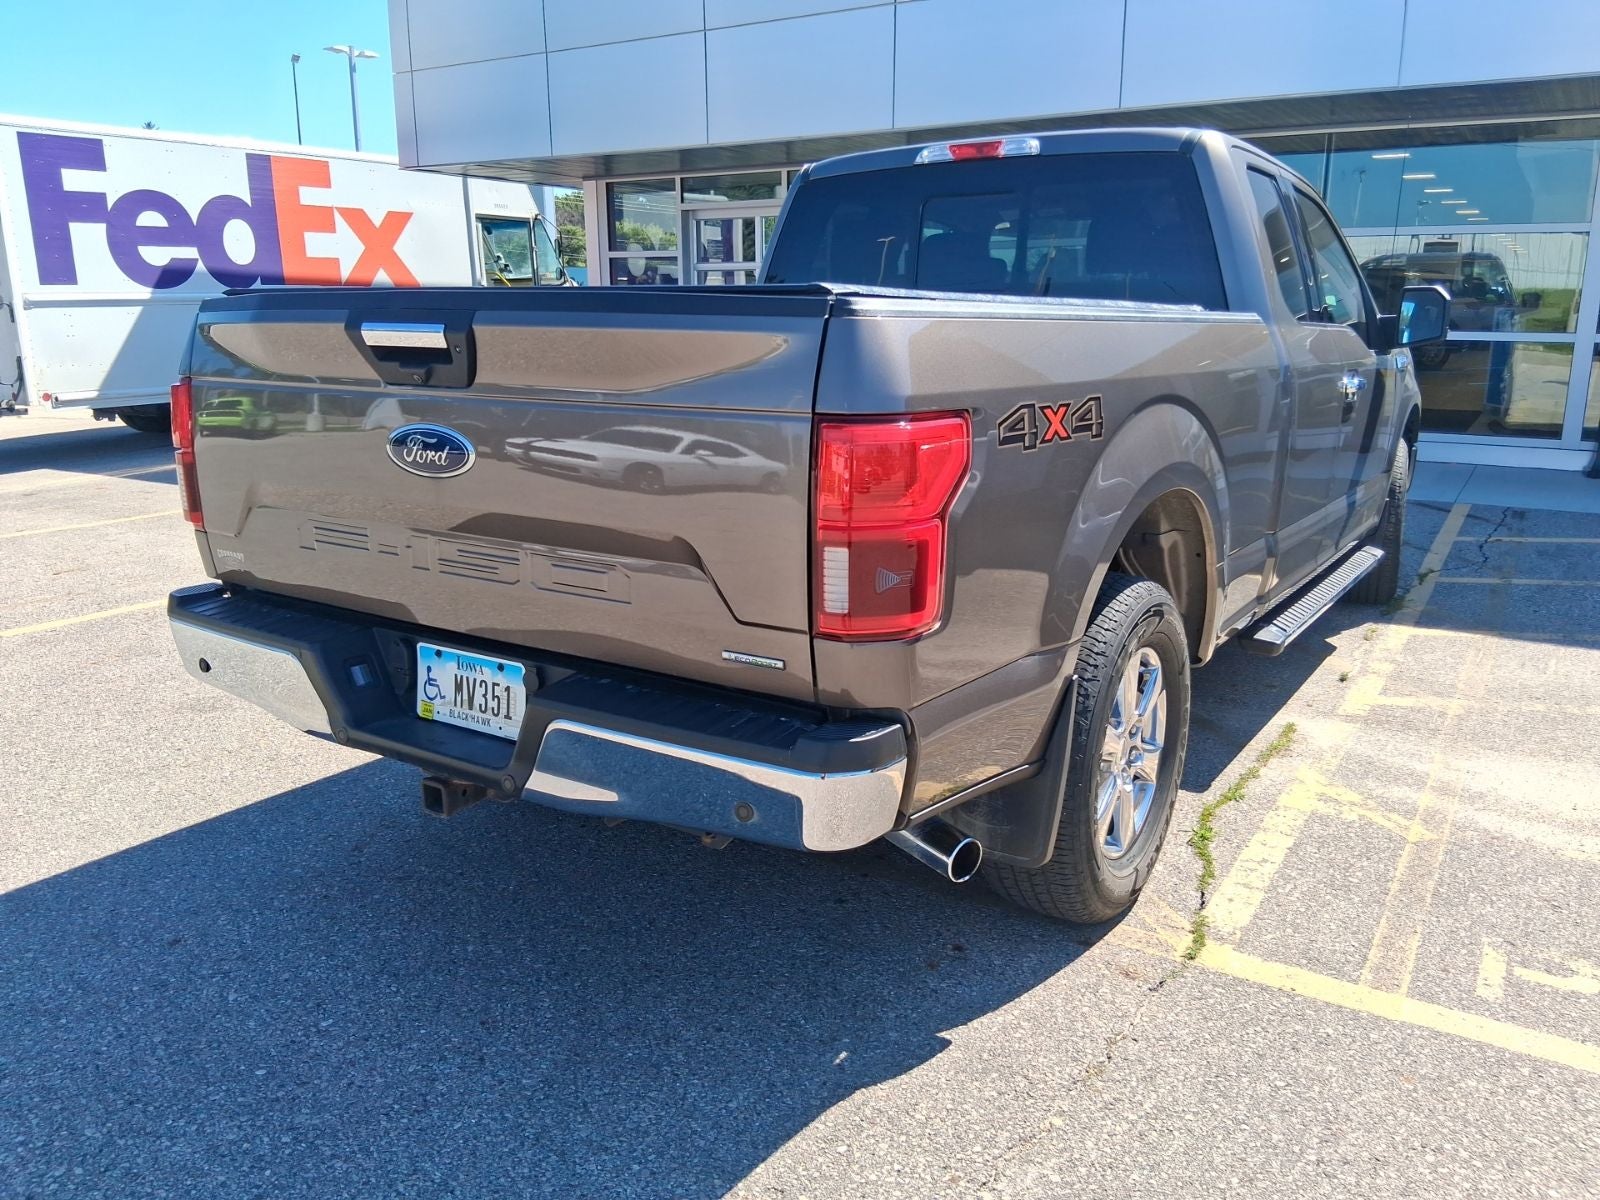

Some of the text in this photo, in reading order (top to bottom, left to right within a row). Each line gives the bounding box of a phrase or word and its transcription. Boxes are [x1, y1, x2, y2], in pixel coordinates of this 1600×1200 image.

[17, 132, 421, 288] FedEx
[403, 434, 450, 466] Ford
[298, 518, 632, 605] F-150
[449, 709, 492, 728] BLACK HAWK
[453, 673, 513, 721] MV351
